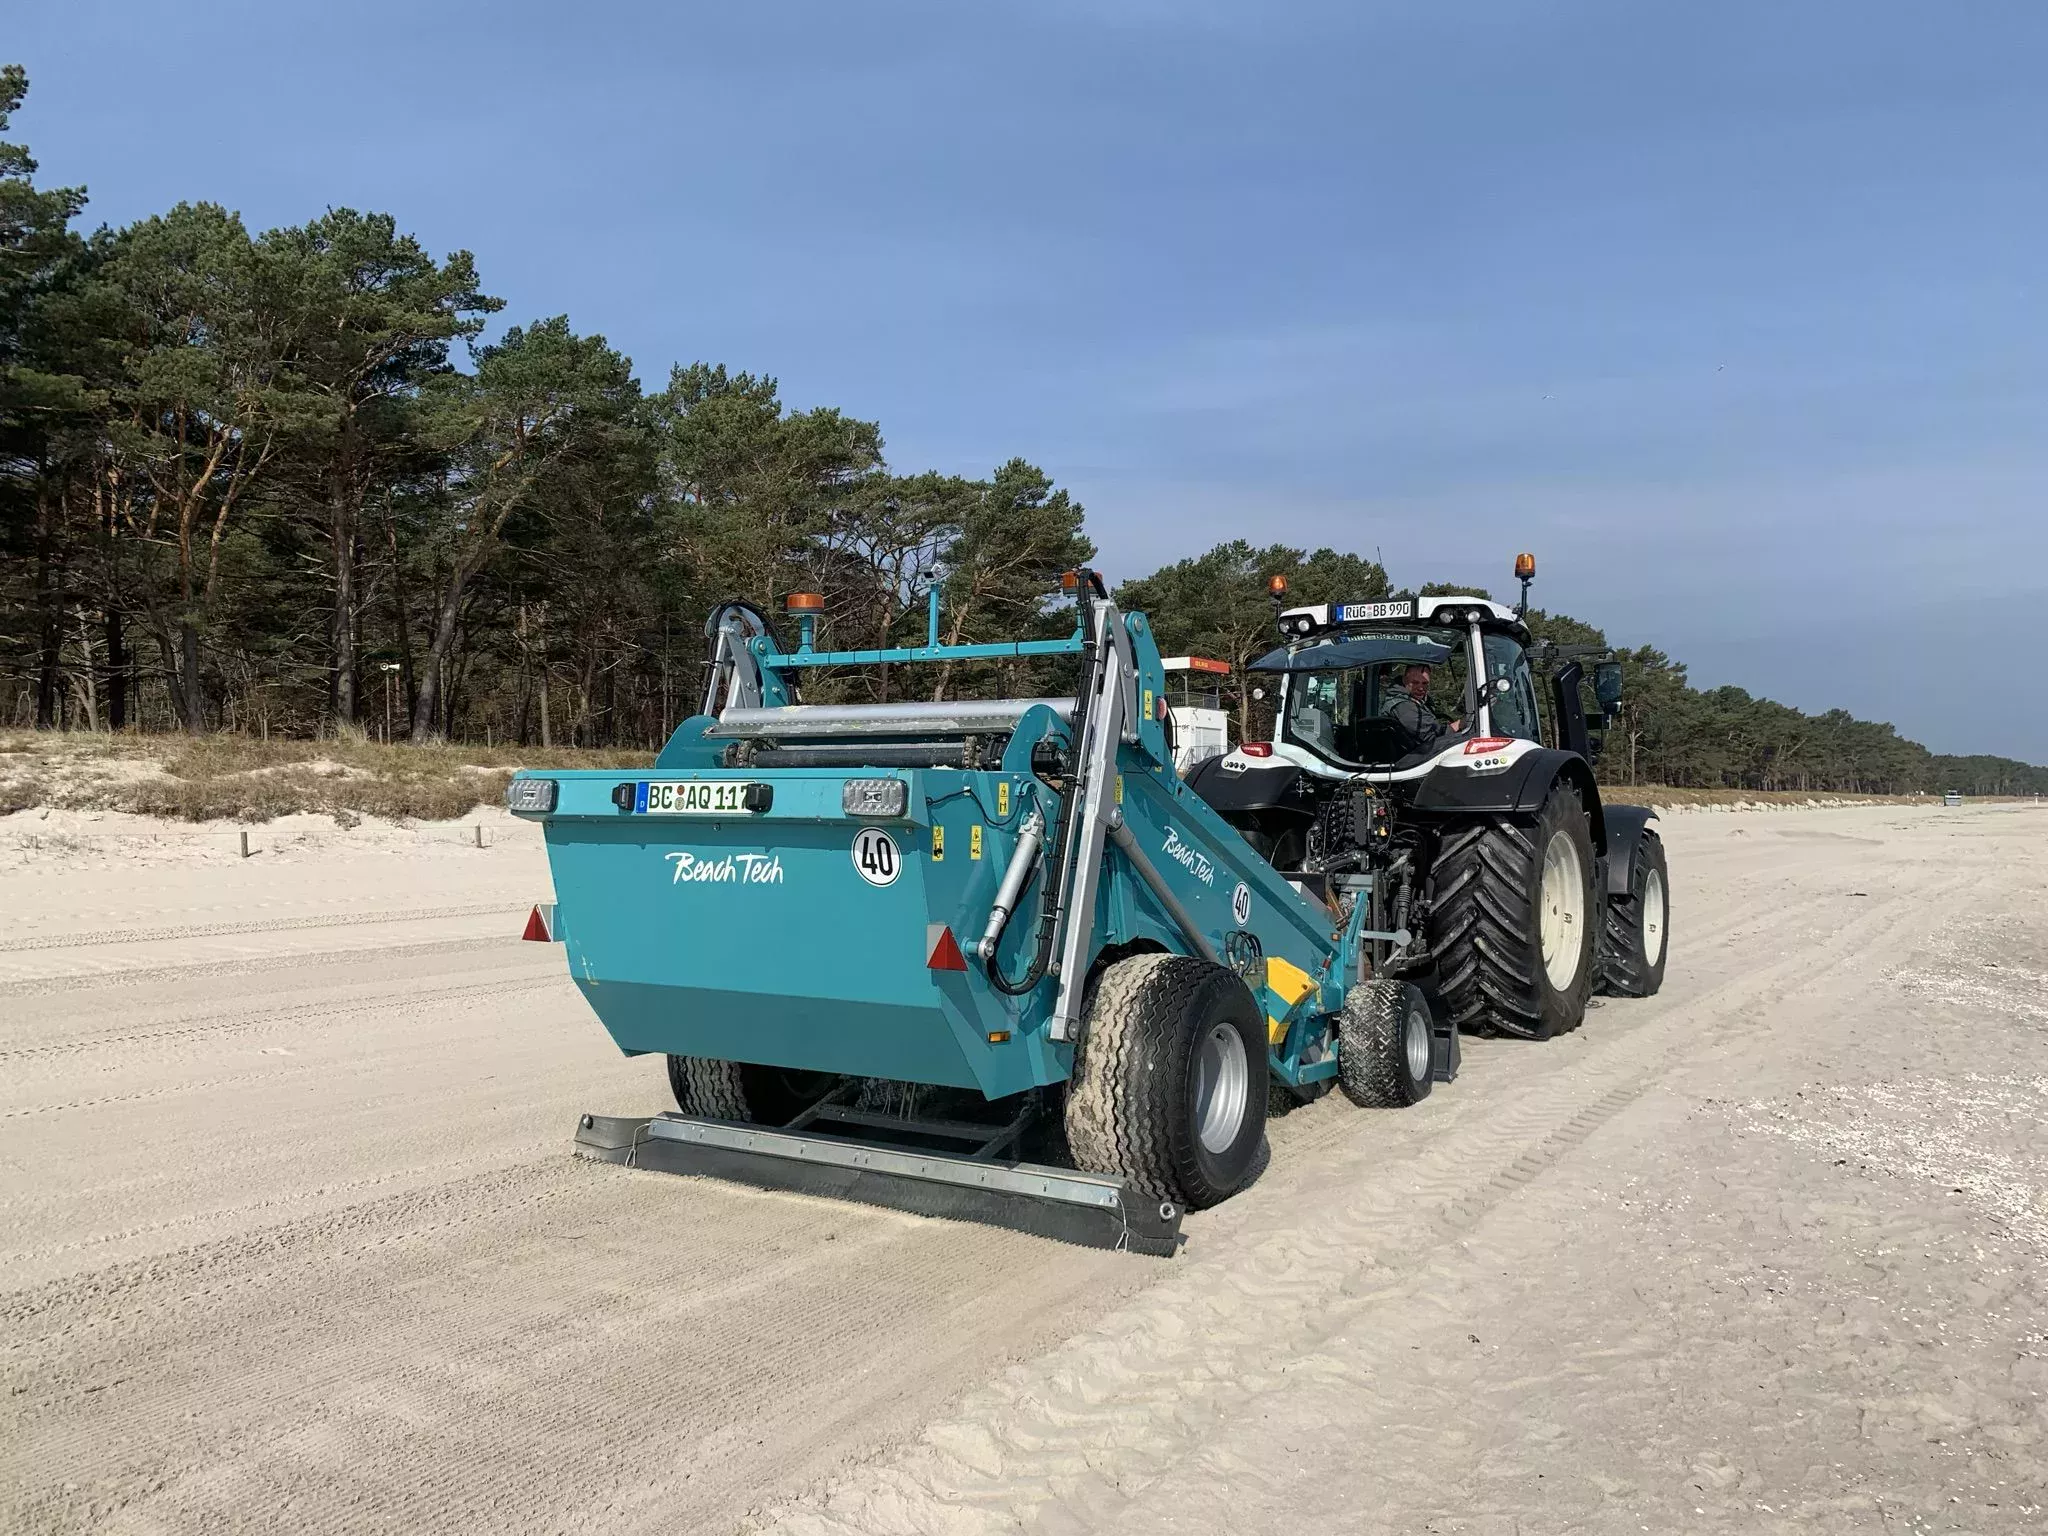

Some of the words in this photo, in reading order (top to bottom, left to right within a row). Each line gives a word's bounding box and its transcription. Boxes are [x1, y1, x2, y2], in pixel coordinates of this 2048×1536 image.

[1345, 605, 1366, 619] RÜG
[1373, 604, 1387, 617] BB
[1389, 602, 1410, 616] 990
[649, 785, 673, 809] BC
[685, 785, 712, 809] AQ
[664, 852, 736, 885] Beach
[735, 853, 784, 884] Tech
[861, 836, 894, 876] 40
[1161, 825, 1196, 871] Beach
[1193, 852, 1215, 888] Tech
[1234, 887, 1249, 920] 40
